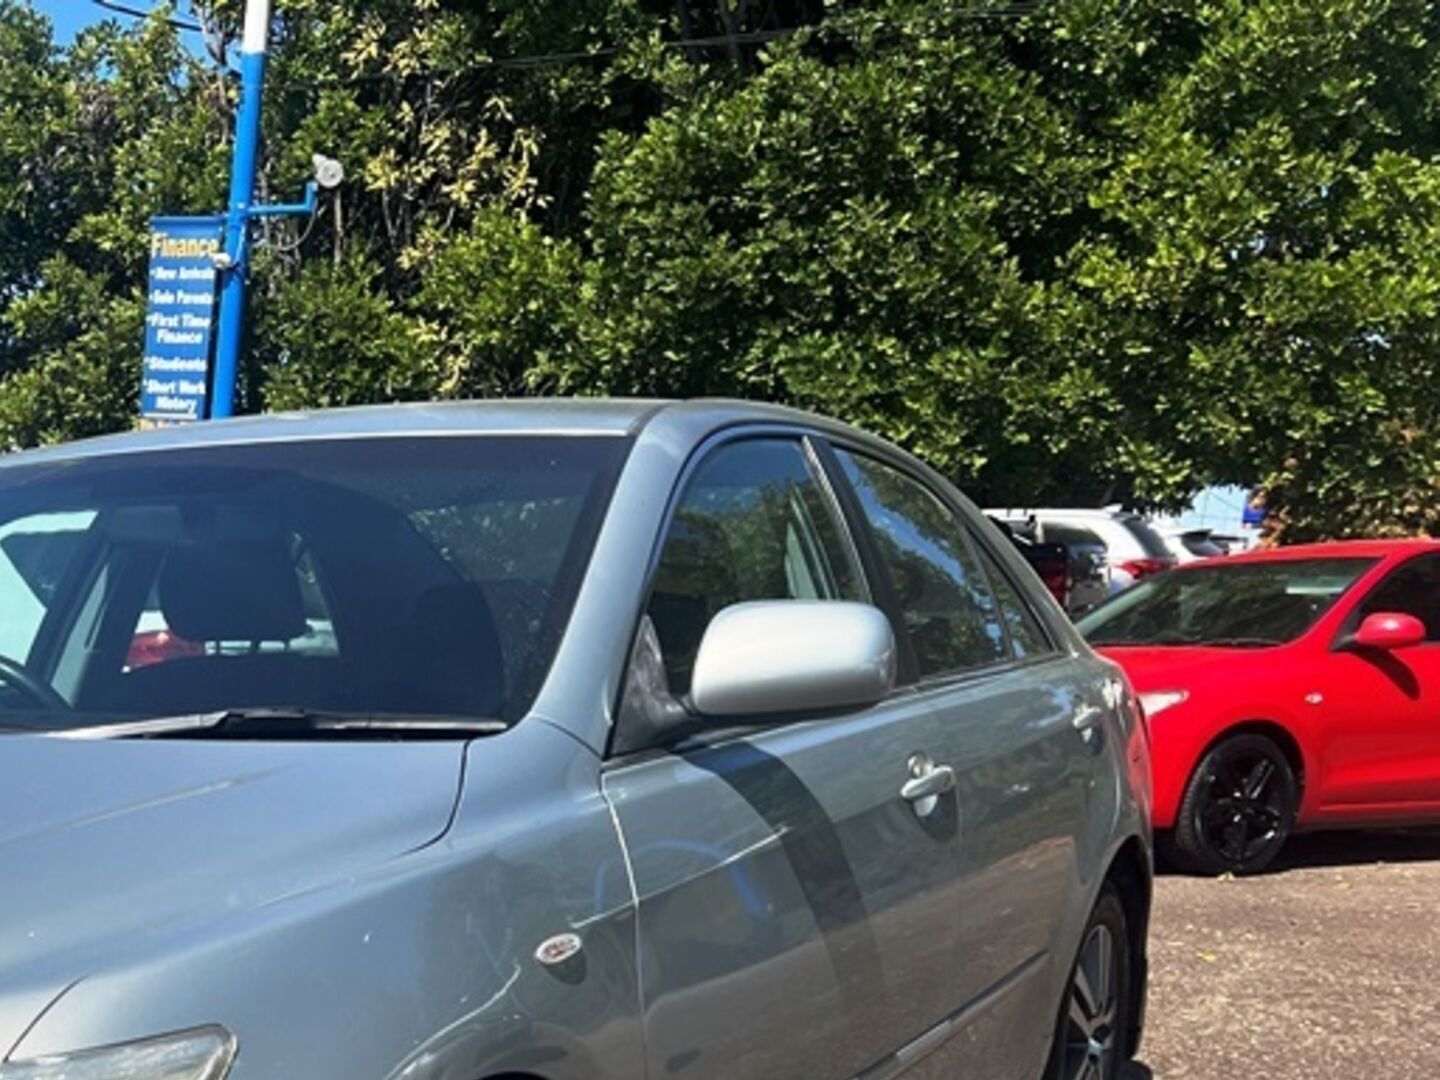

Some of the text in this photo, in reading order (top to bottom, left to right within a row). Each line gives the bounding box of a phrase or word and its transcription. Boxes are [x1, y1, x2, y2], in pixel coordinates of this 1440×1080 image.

[151, 232, 219, 258] Finance
[151, 312, 212, 329] First Time
[156, 328, 204, 345] Finance
[148, 355, 208, 372] Students
[146, 379, 176, 395] Short
